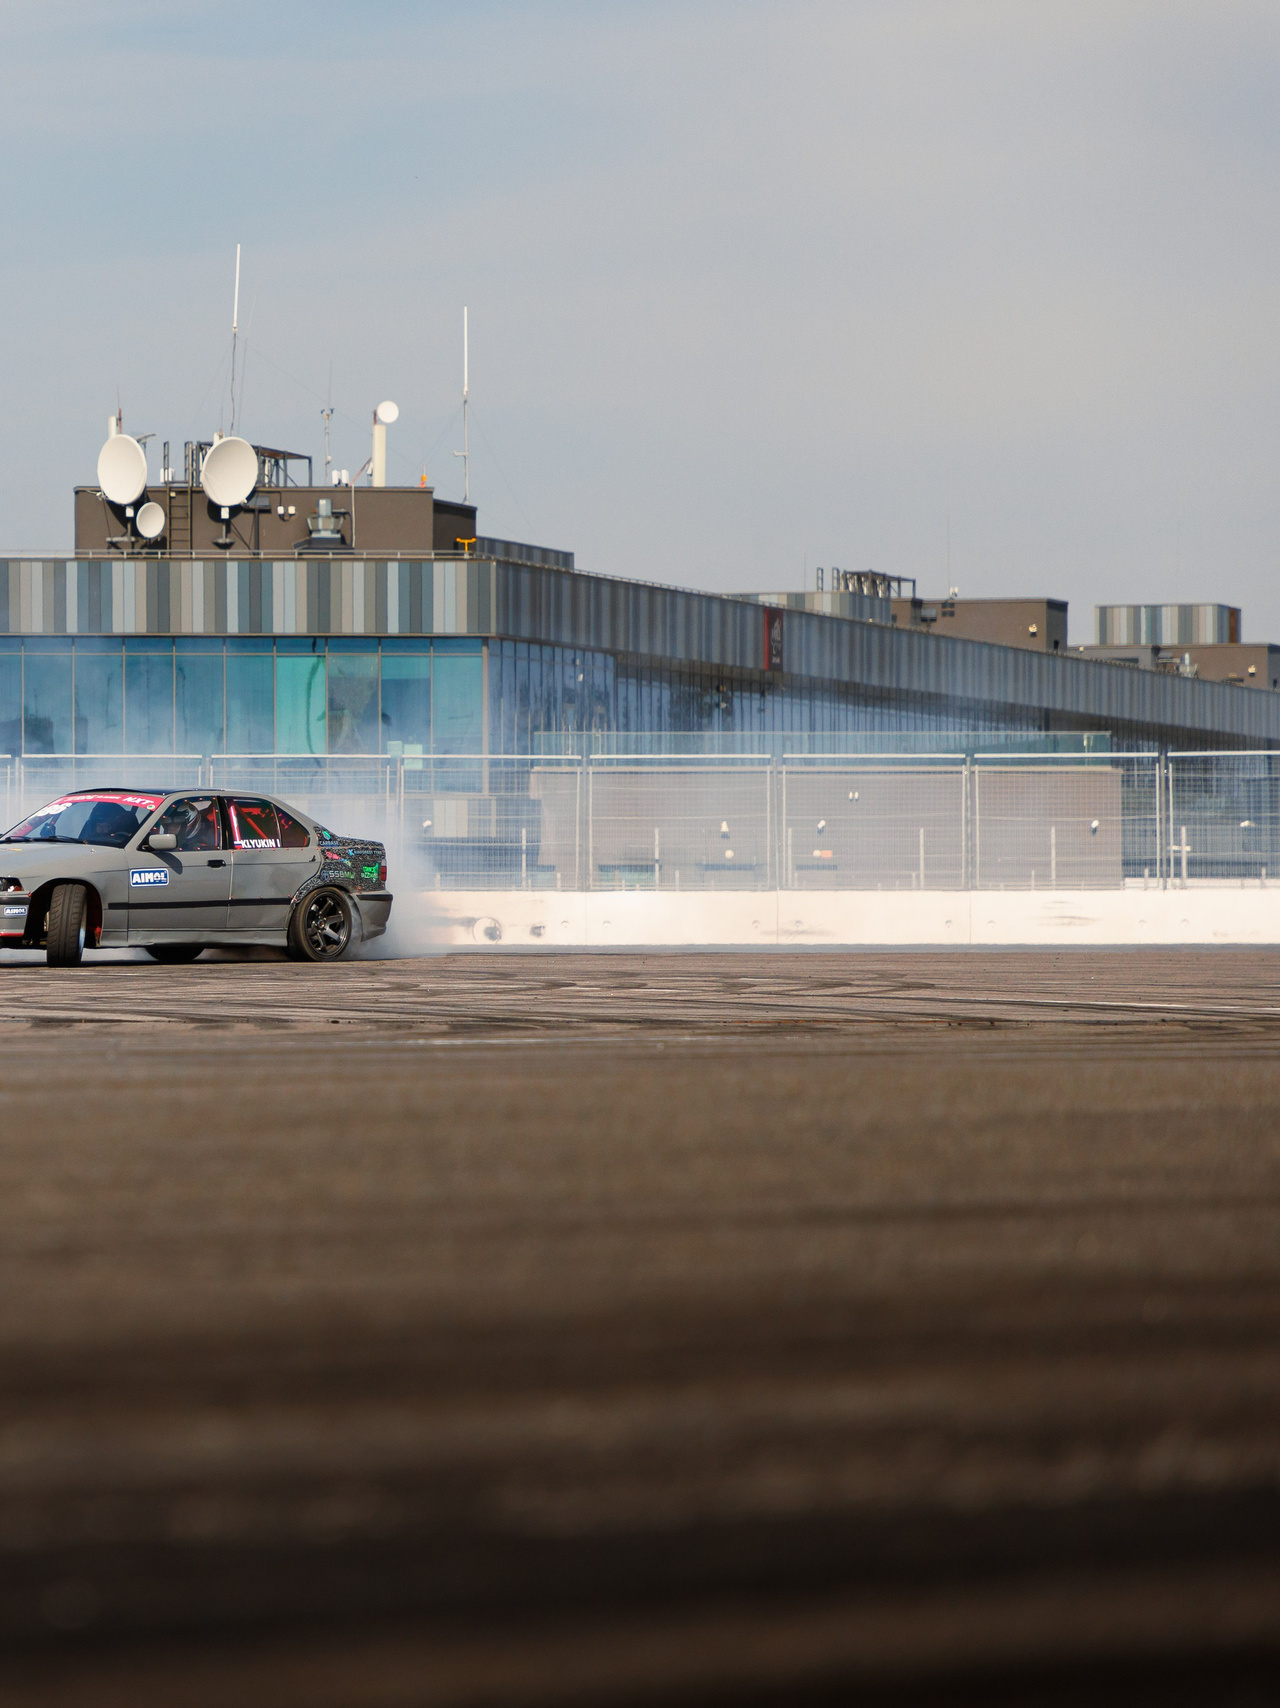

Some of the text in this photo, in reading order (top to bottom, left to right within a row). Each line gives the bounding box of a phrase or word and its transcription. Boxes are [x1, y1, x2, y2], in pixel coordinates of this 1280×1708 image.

[122, 796, 154, 805] NXT
[241, 839, 276, 848] KLYUKIN
[132, 872, 167, 884] AIMOL
